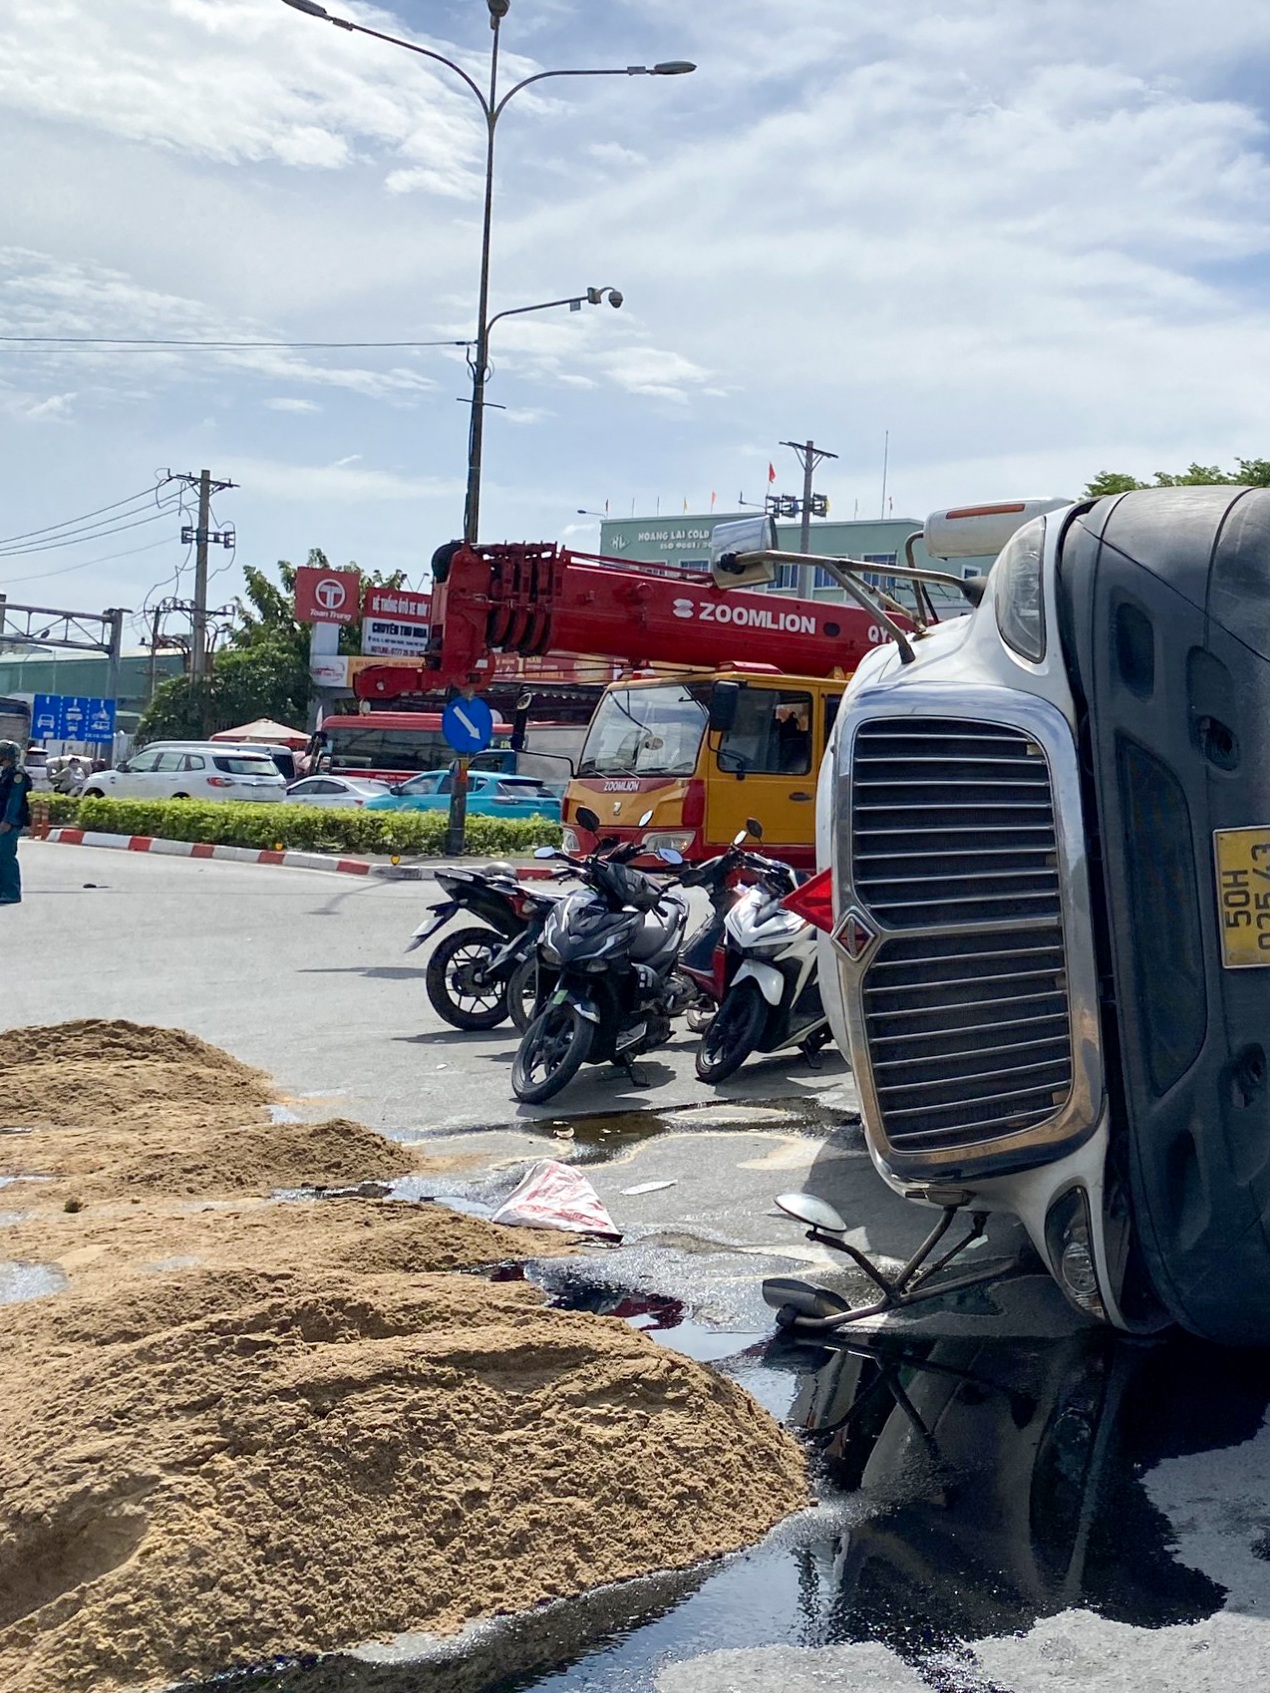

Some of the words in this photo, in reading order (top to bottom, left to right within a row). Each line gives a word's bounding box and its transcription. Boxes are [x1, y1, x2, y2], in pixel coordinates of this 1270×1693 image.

[638, 531, 669, 541] HOANG
[671, 530, 685, 540] LAI
[699, 602, 816, 635] ZOOMLION
[604, 780, 640, 792] ZOOMLION
[1221, 869, 1252, 928] 50H
